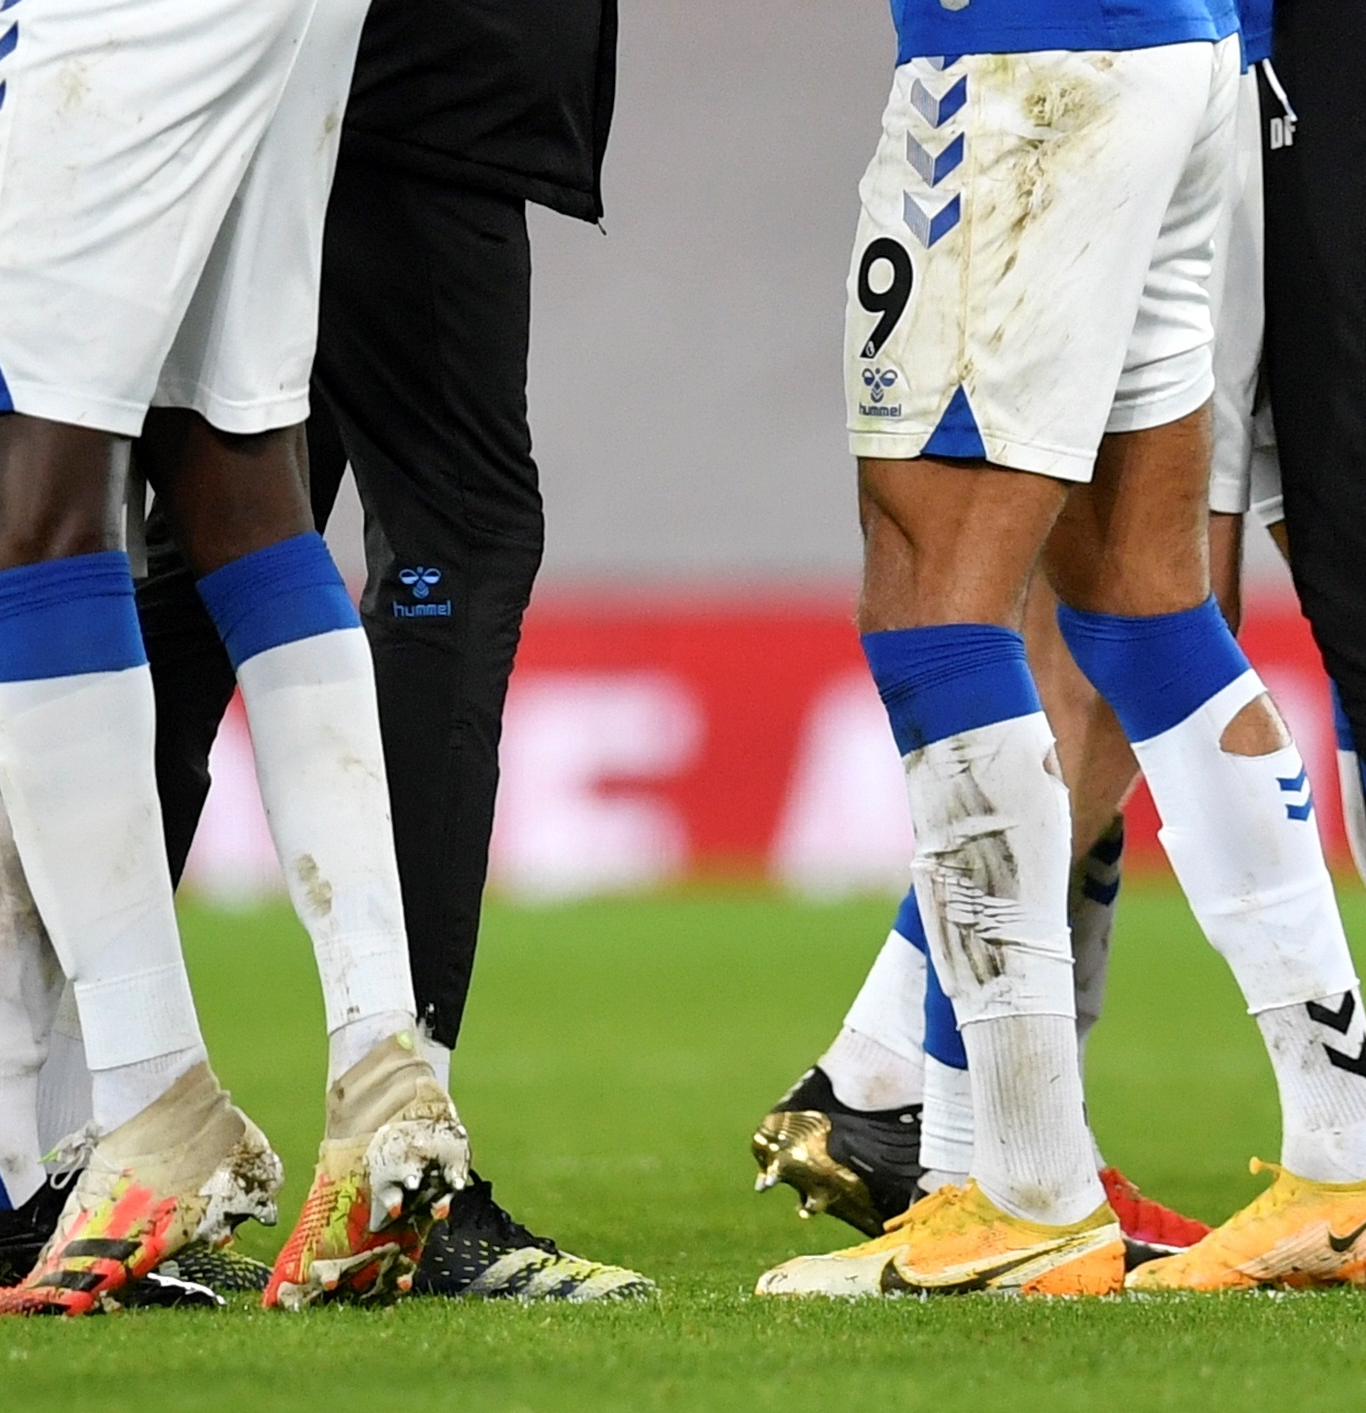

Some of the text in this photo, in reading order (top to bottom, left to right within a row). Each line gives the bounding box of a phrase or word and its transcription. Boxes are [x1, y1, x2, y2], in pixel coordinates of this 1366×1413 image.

[1270, 115, 1297, 149] DF
[858, 238, 913, 358] 9
[859, 402, 902, 417] hummel
[393, 600, 452, 617] hummel
